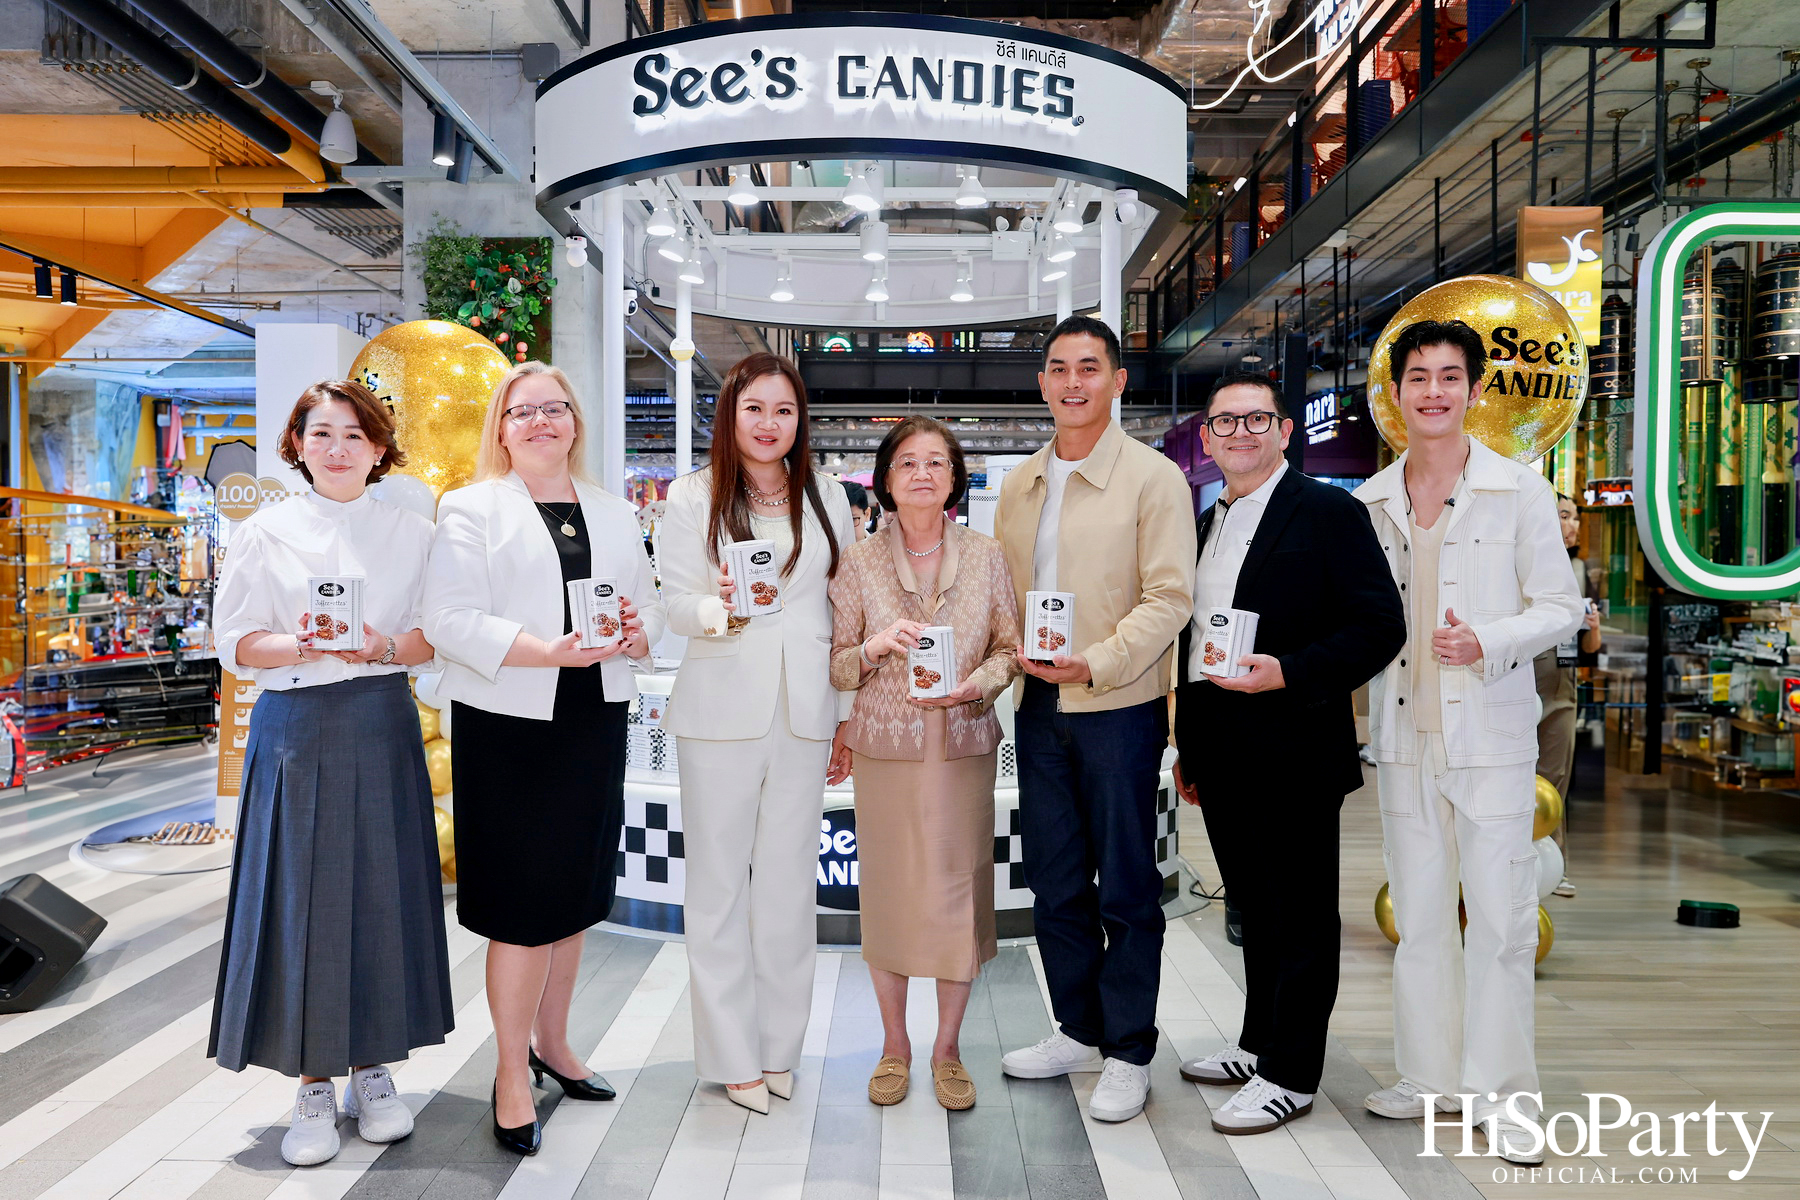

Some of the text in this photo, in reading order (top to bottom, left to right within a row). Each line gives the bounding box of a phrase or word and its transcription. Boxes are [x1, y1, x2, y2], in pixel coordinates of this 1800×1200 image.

[996, 40, 1066, 69] ซีส์ แคนดีส์
[632, 48, 1076, 119] See's CANDIES
[1484, 369, 1585, 400] ANDIE
[219, 485, 257, 503] 100
